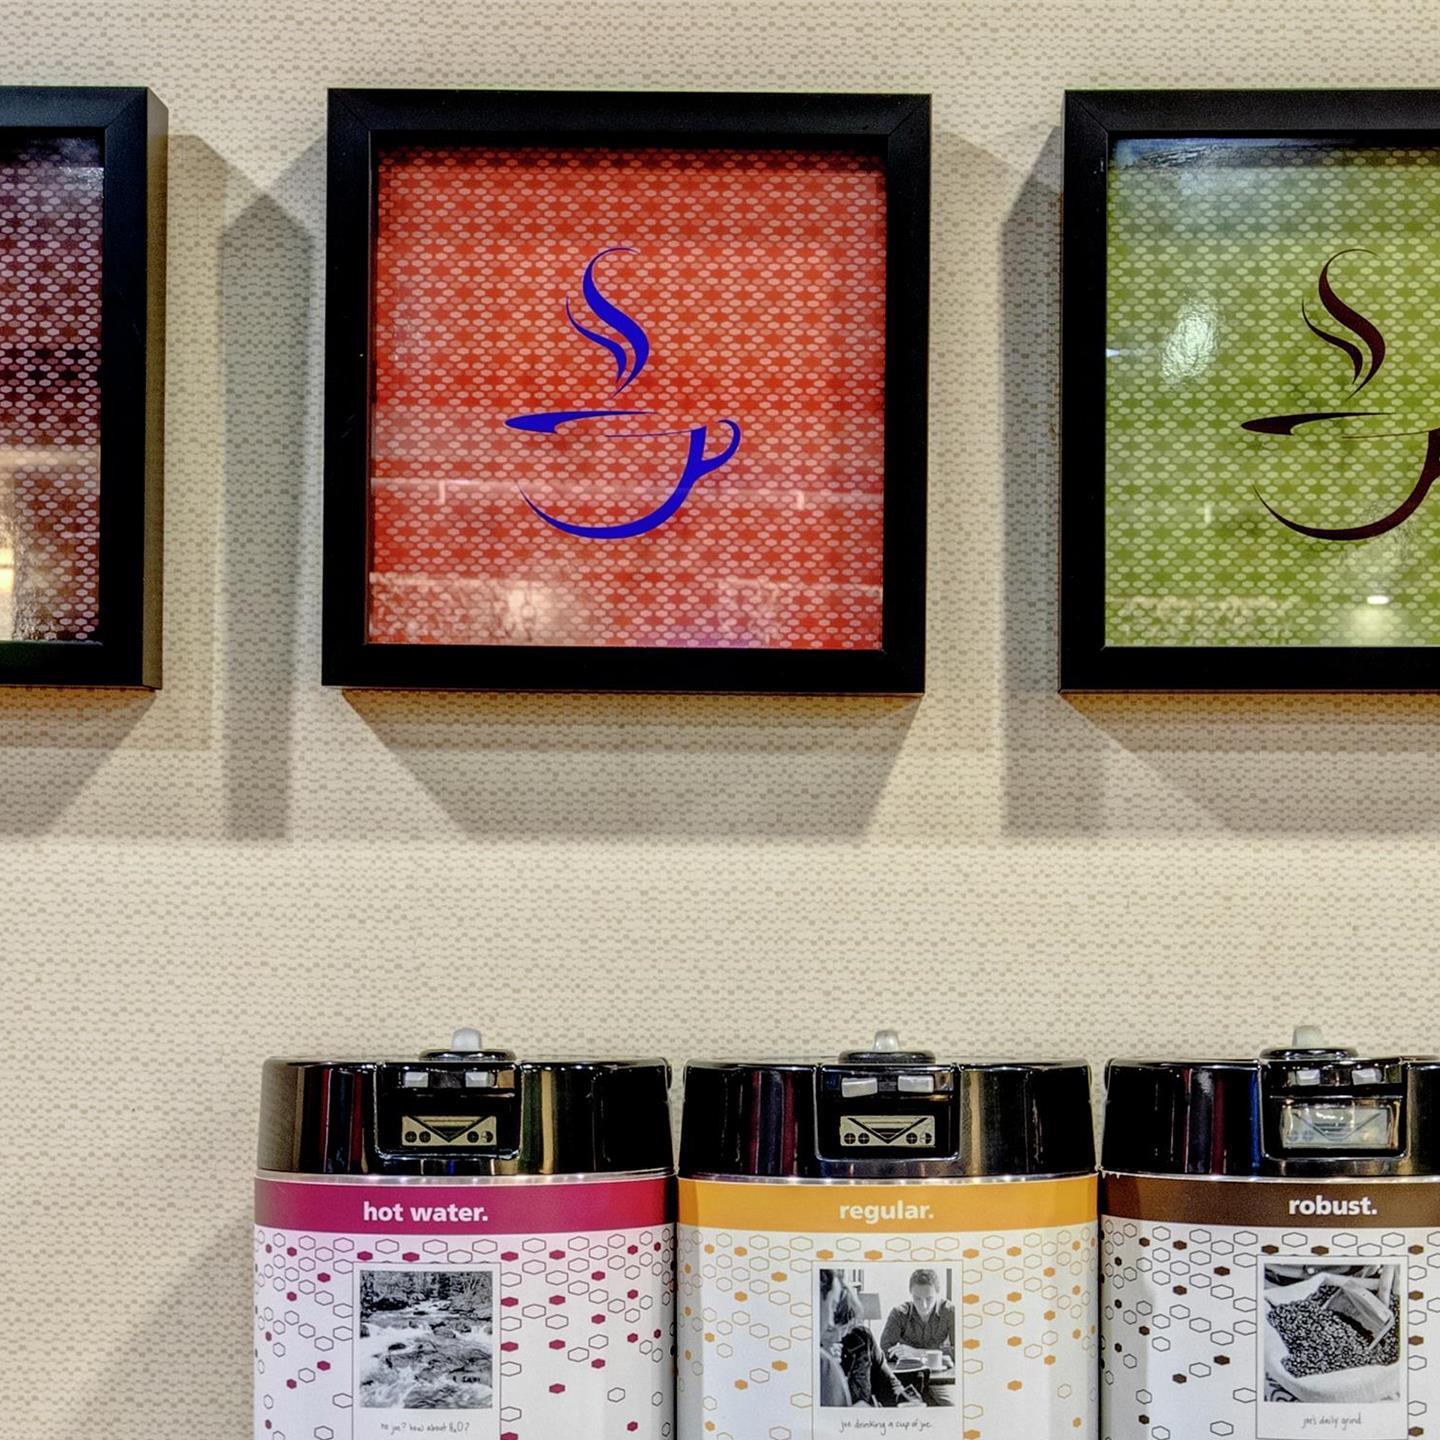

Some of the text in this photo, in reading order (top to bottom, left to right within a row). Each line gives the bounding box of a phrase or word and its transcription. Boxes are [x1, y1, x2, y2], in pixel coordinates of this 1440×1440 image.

[363, 1201, 488, 1222] hot water.
[839, 1200, 934, 1225] regular.
[1288, 1195, 1378, 1215] robust.
